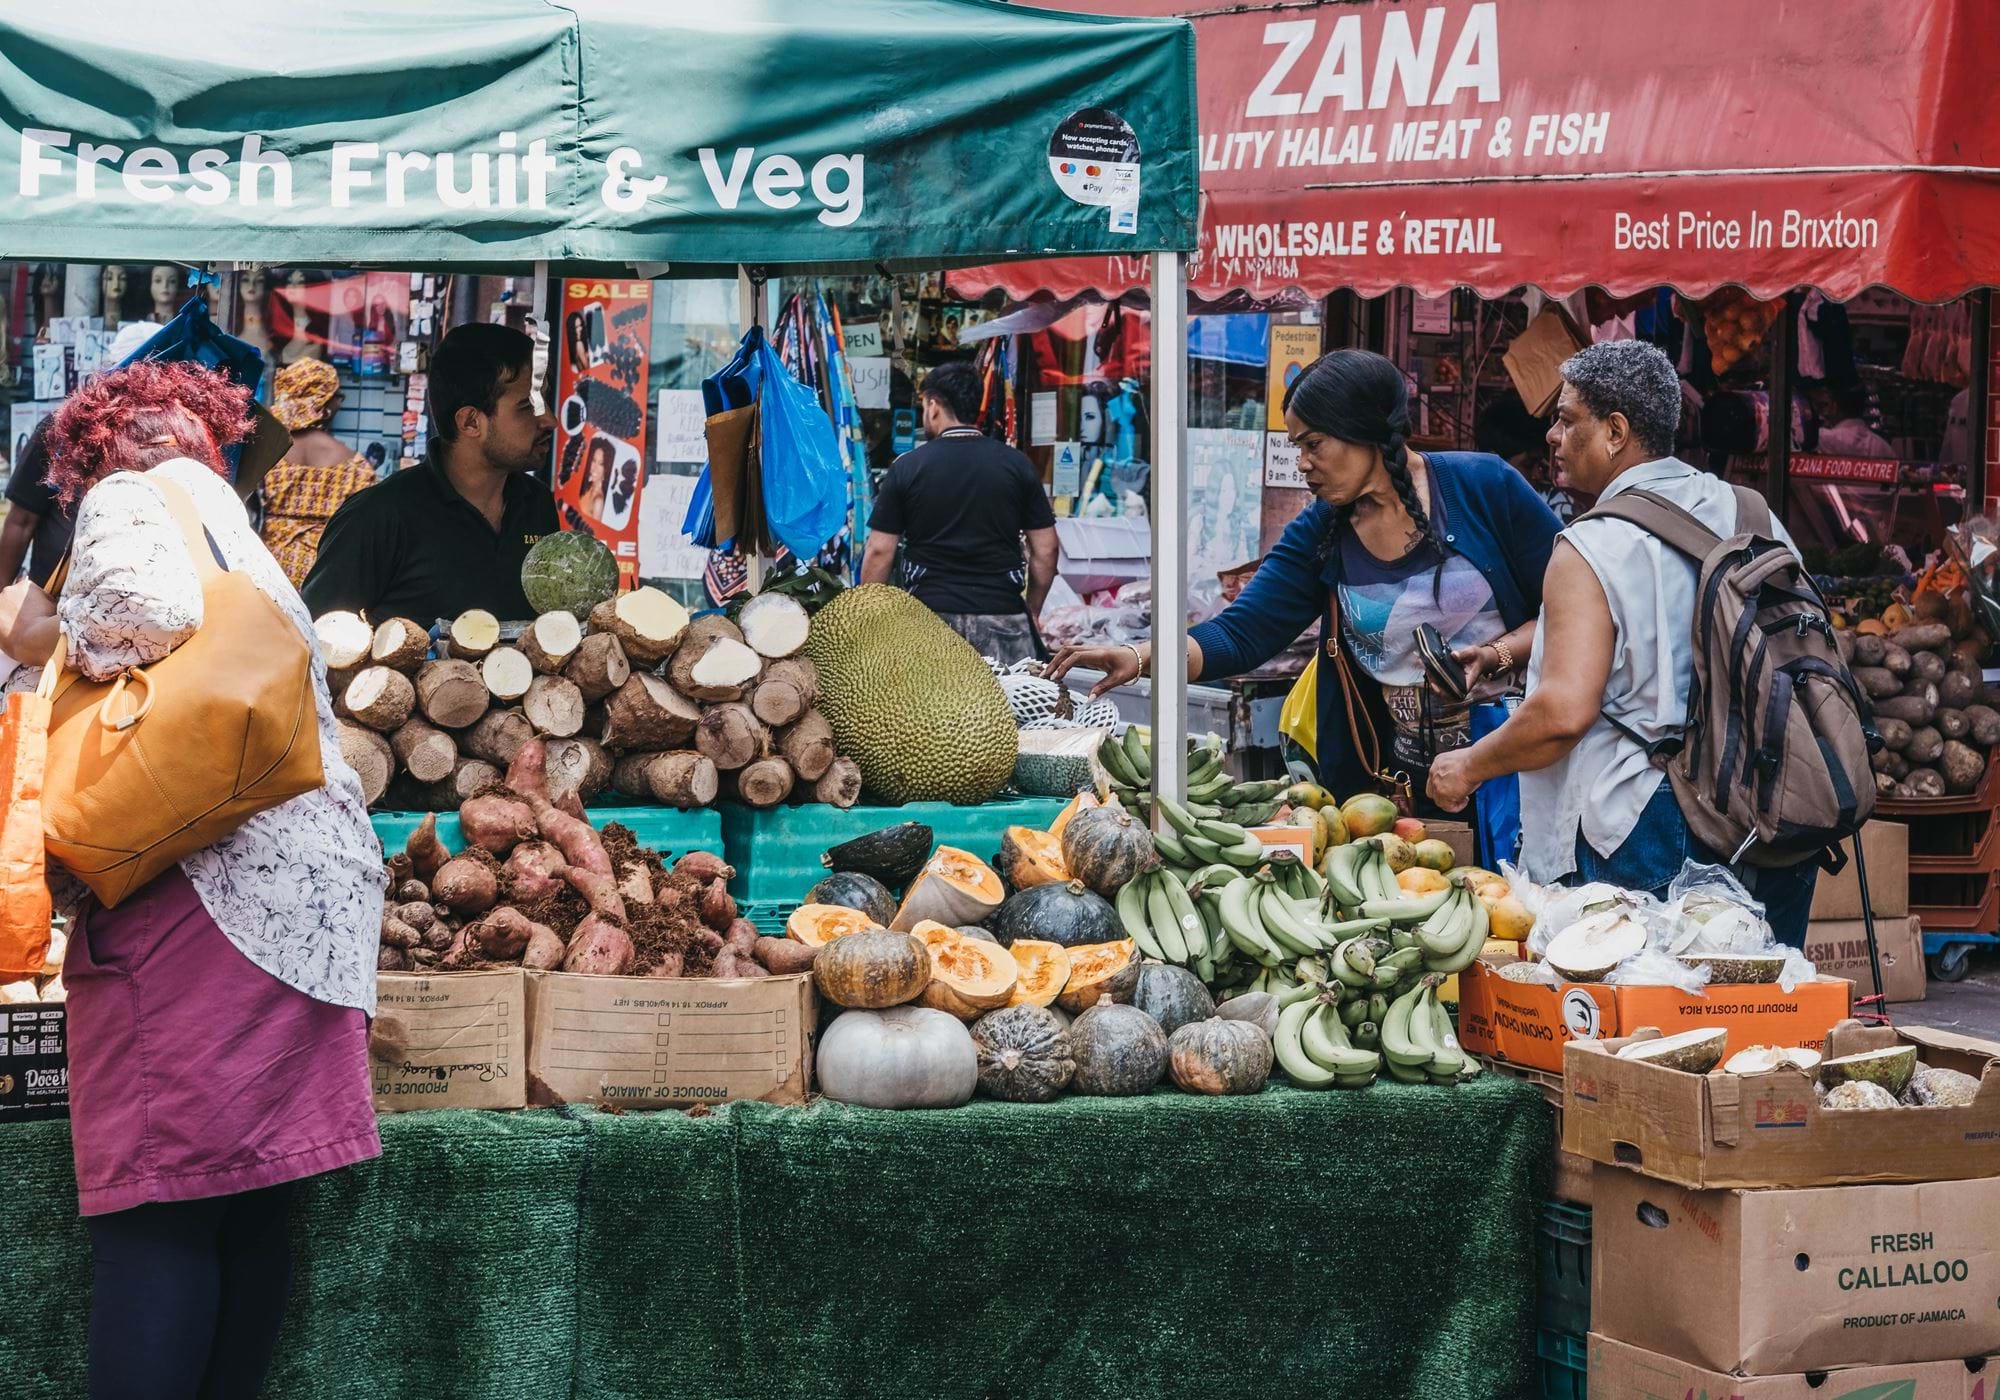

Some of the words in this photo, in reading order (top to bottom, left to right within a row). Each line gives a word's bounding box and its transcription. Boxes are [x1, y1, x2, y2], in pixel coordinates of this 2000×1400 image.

[1245, 2, 1501, 118] ZANA
[1062, 133, 1078, 141] Now
[1079, 137, 1109, 146] accepting
[1199, 130, 1275, 172] LITY
[1277, 124, 1378, 168] HALAL
[1387, 118, 1482, 162] MEAT
[1487, 117, 1513, 159] &
[1523, 112, 1611, 157] FISH
[1066, 143, 1095, 151] watches,
[19, 127, 293, 207] Fresh
[330, 131, 557, 210] Fruit
[601, 146, 668, 212] &
[698, 147, 864, 227] Veg
[1089, 183, 1103, 194] Pay
[1615, 212, 1670, 250] Best
[1678, 211, 1741, 249] Price
[1750, 210, 1772, 248] In
[1781, 209, 1878, 249] Brixton
[1215, 221, 1368, 258] WHOLESALE
[1376, 219, 1395, 255] &
[1403, 217, 1502, 255] RETAIL
[568, 283, 649, 299] SALE
[844, 333, 876, 349] PEN
[1275, 331, 1317, 342] Pedestrian
[1285, 345, 1304, 355] Zone
[1270, 437, 1281, 448] No
[1272, 454, 1289, 466] Mon
[1268, 470, 1274, 481] 9
[1275, 472, 1287, 481] am
[1796, 458, 1822, 473] ZANA
[1825, 460, 1851, 475] FOOD
[1853, 461, 1894, 479] CENTRE
[1807, 943, 1835, 961] ESH
[1834, 961, 1845, 970] OF
[613, 998, 630, 1007] NET
[694, 1000, 728, 1009] APPROX.
[1705, 1004, 1739, 1014] COSTA
[1740, 1003, 1754, 1013] DU
[1756, 1003, 1798, 1013] PRODUIT
[1679, 1005, 1702, 1015] RICA
[1494, 1010, 1520, 1034] CHOW
[1521, 1021, 1553, 1041] CHOW
[376, 1083, 391, 1096] OF
[394, 1081, 449, 1095] PRODUCE
[600, 1084, 651, 1098] JAMAICA
[653, 1085, 670, 1098] OF
[672, 1085, 728, 1099] PRODUCE
[1755, 1099, 1808, 1123] Dole
[1870, 1231, 1934, 1253] FRESH
[1838, 1259, 1969, 1291] CALLALOO
[1843, 1313, 1898, 1329] PRODUCT
[1900, 1312, 1916, 1325] OF
[1917, 1308, 1966, 1324] JAMAICA
